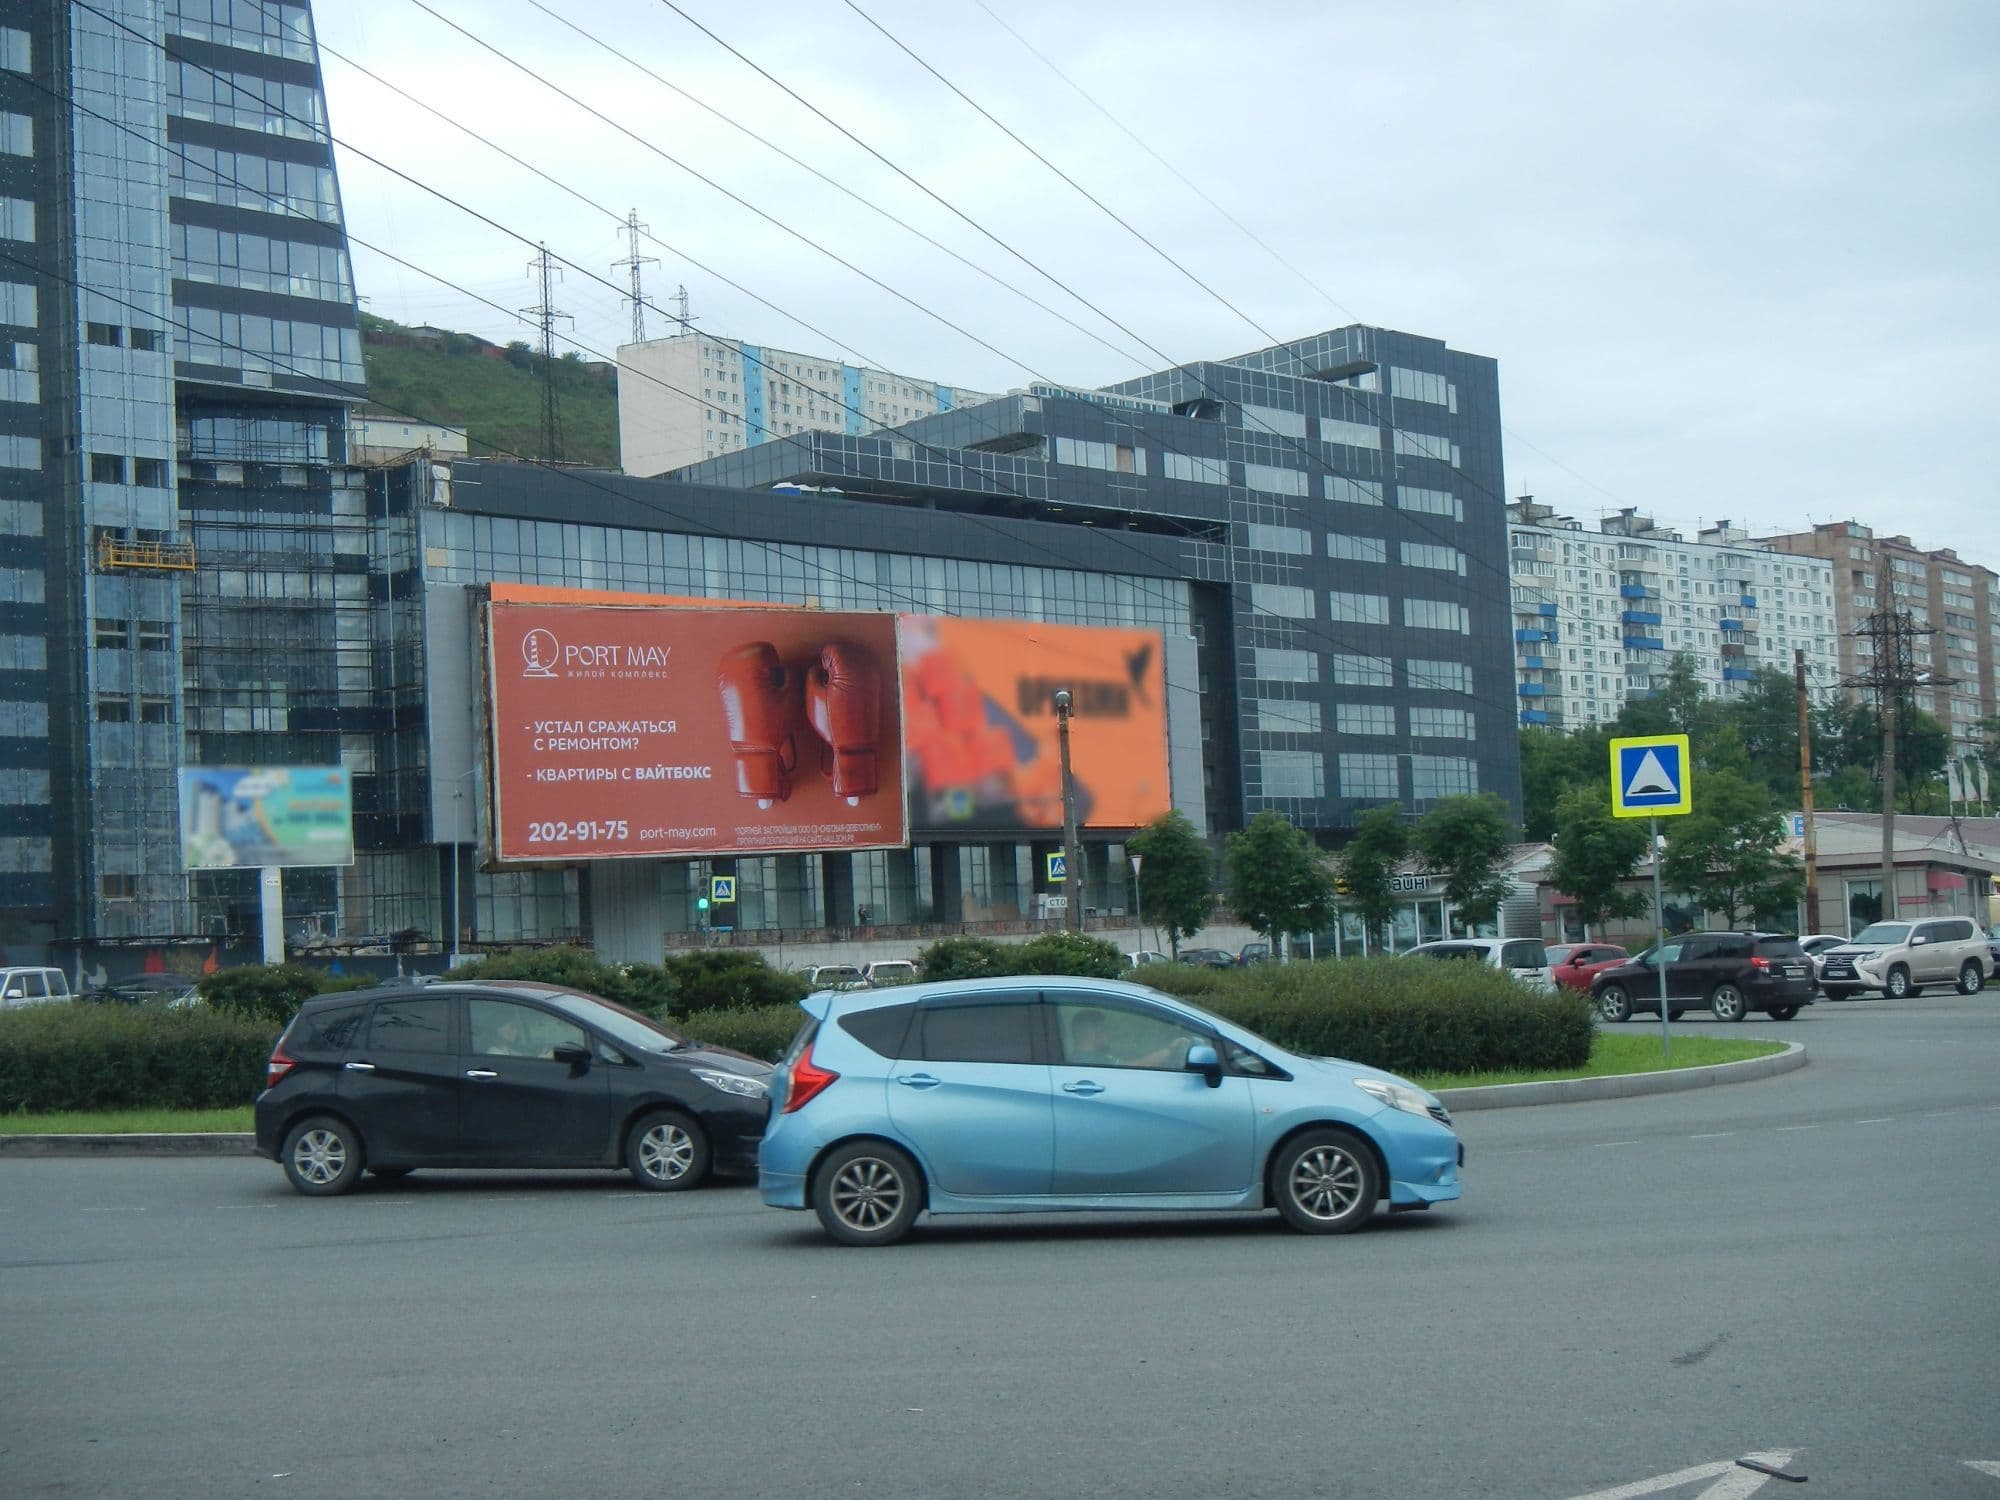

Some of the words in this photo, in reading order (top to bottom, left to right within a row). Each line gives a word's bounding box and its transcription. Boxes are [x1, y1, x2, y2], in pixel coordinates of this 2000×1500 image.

[565, 645, 621, 666] PORT
[627, 646, 672, 666] MAY
[534, 721, 584, 734] УСТАЛ
[588, 720, 677, 733] СРАЖАТЬСЯ
[534, 738, 544, 751] С
[549, 737, 640, 751] РЕМОНТОМ?
[536, 768, 617, 781] КВАРТИРЫ
[621, 767, 632, 780] С
[635, 764, 712, 780] ВАЙТБОКС
[528, 820, 629, 842] 202-91-75
[640, 826, 717, 840] port-may.com
